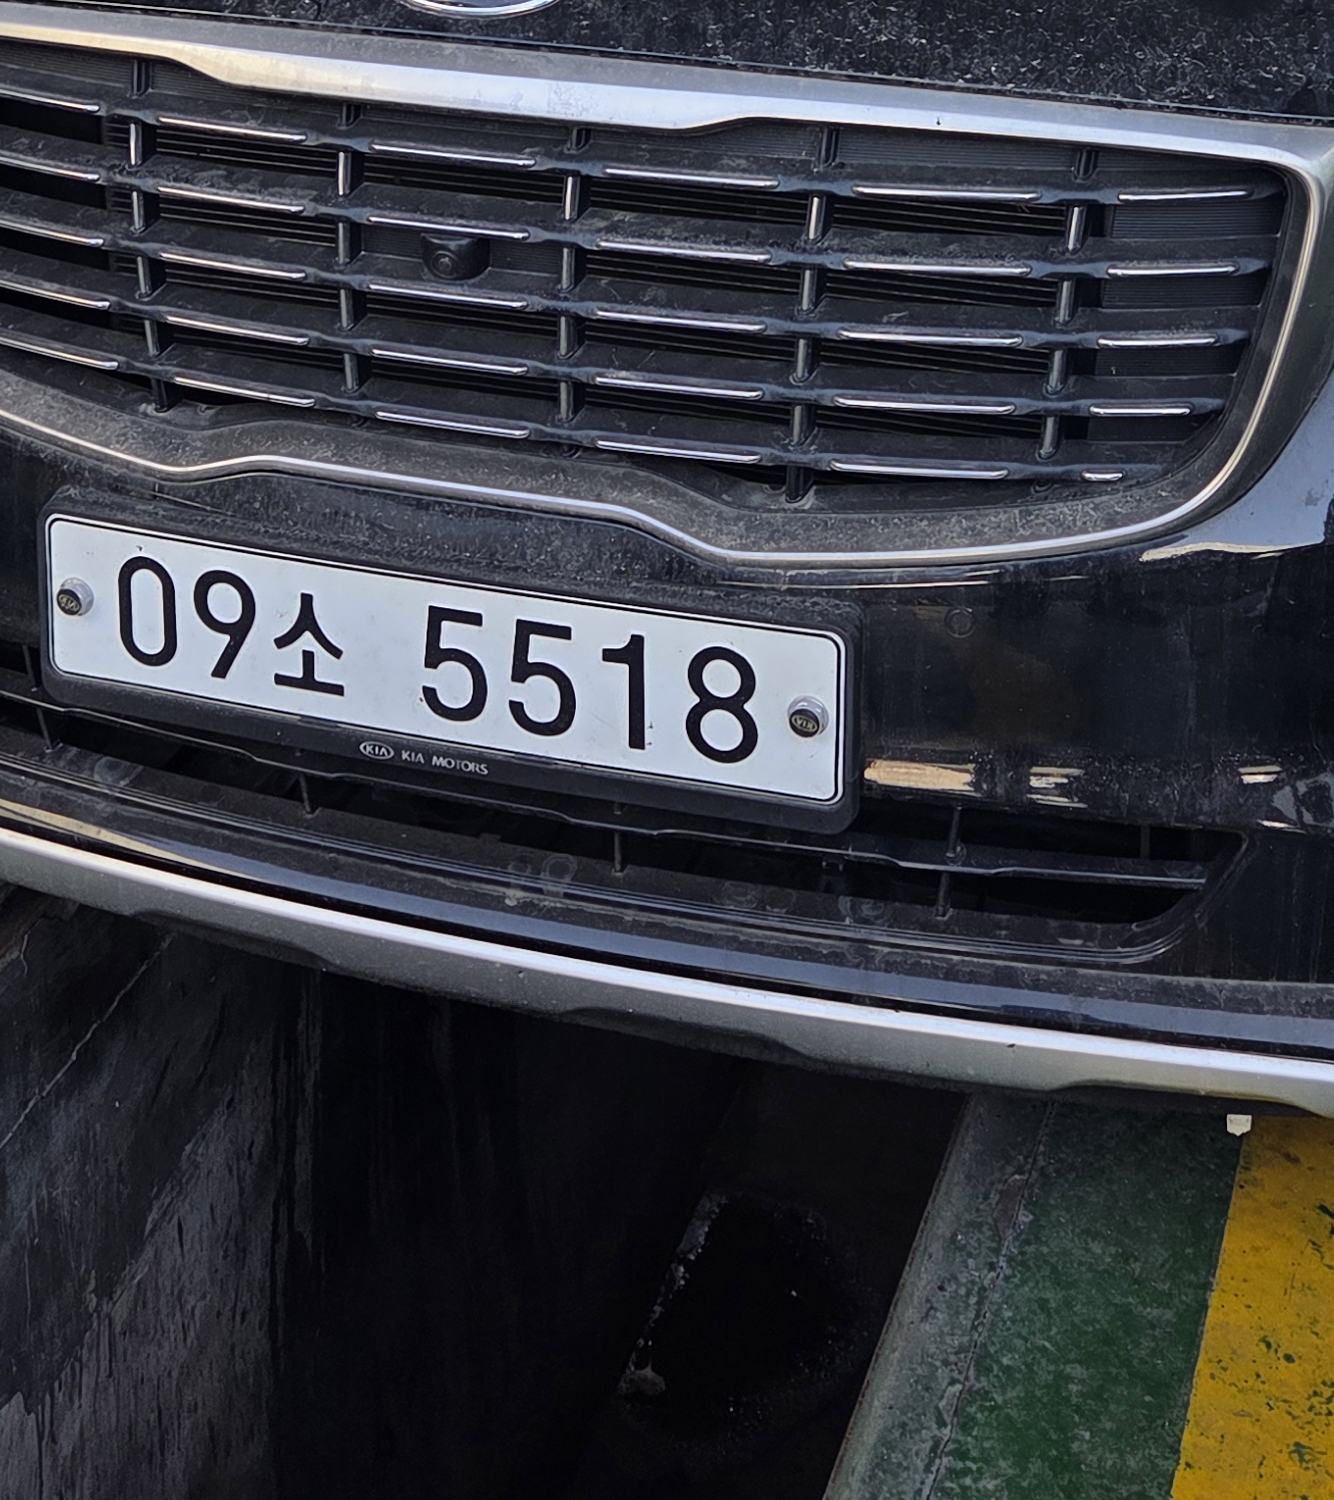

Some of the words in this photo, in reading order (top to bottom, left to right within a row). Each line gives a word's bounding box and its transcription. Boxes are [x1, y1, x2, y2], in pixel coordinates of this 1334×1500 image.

[116, 553, 346, 698] 09소
[419, 604, 760, 764] 5518
[401, 750, 425, 764] KIA
[431, 755, 489, 776] MOTORS
